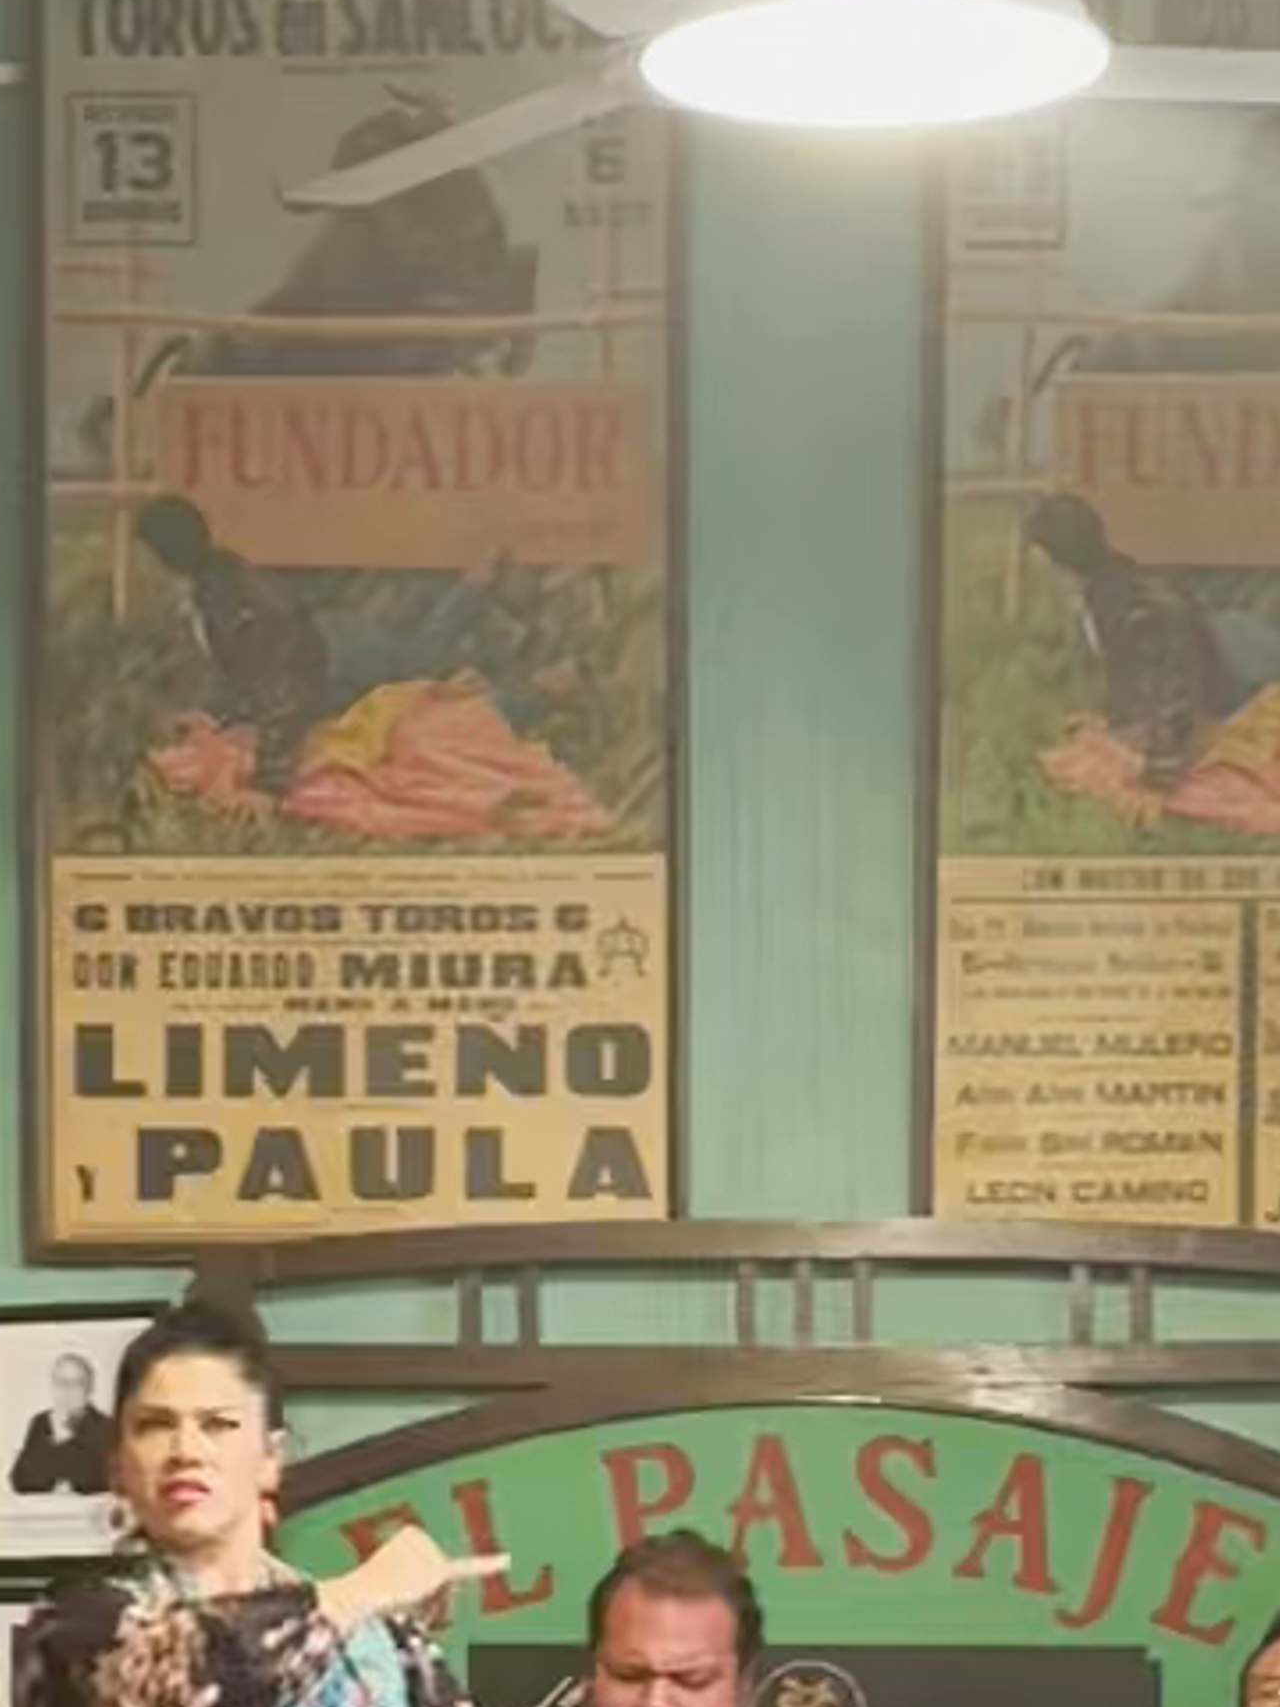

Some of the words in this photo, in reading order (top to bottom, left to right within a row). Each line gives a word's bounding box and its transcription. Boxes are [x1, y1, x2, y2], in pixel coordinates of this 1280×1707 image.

[93, 130, 173, 193] 13
[180, 400, 624, 493] FUNDADOR
[123, 902, 342, 934] BRAVOS
[357, 903, 539, 934] TOROS
[73, 951, 138, 991] DON
[157, 950, 317, 991] EDUARDO
[339, 950, 588, 990] MIURA
[136, 1125, 653, 1202] PAULA
[600, 1432, 1269, 1647] PASAJE
